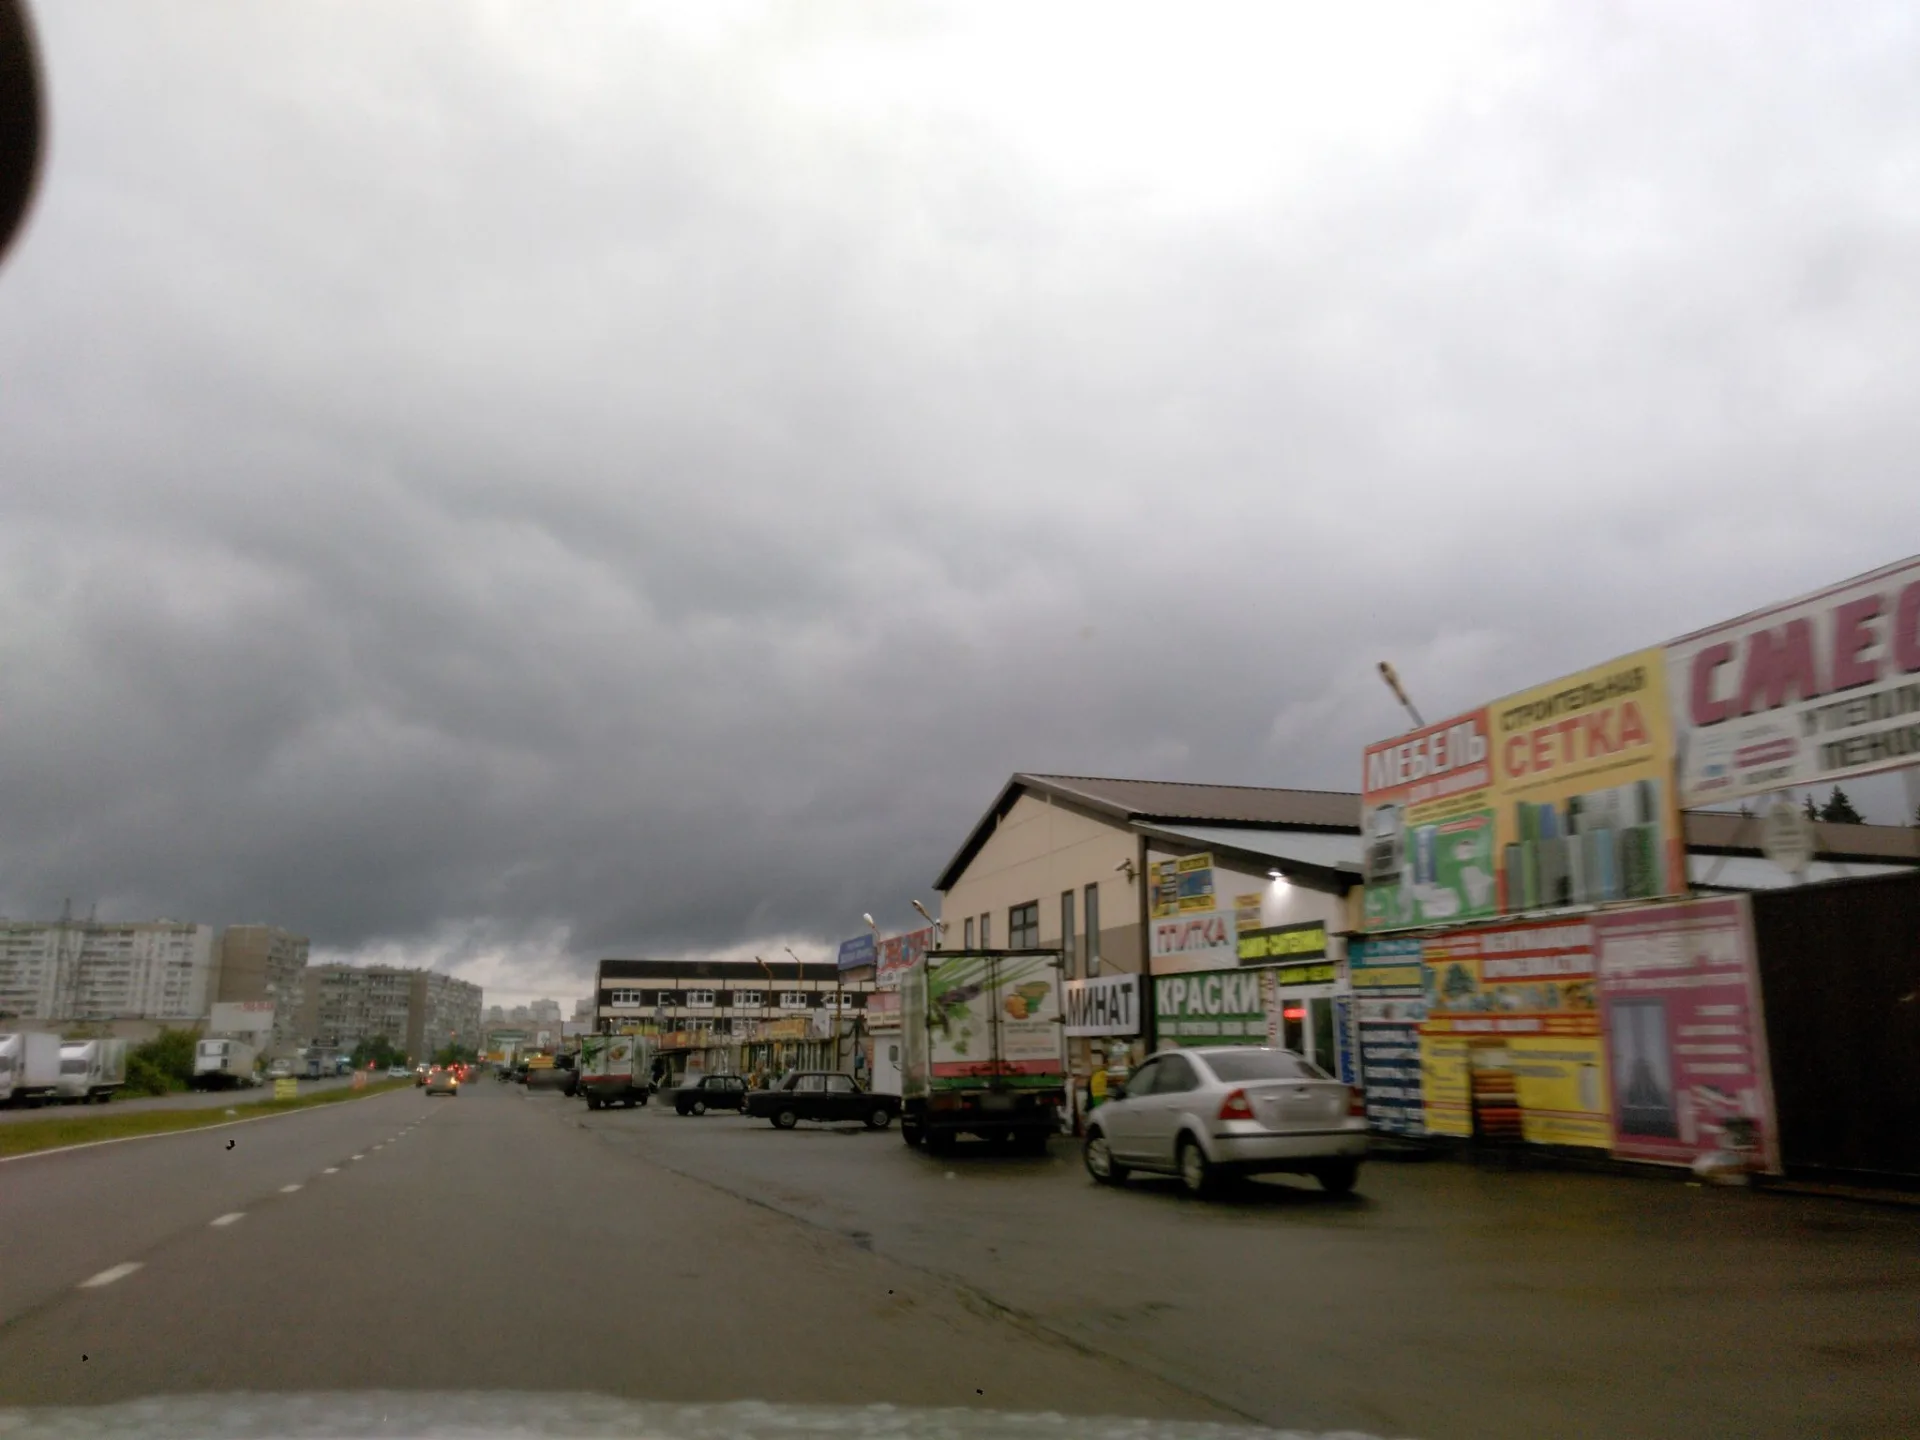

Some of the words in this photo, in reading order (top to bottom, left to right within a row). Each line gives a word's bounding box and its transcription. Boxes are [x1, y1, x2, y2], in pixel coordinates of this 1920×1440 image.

[1501, 666, 1648, 731] СТРОИТЕЛЬНАЯ
[1368, 719, 1487, 791] МЕБЕЛЬ
[1503, 699, 1652, 777] СЕТКА
[1067, 983, 1133, 1027] МИНАТ
[1157, 975, 1260, 1015] КРАСКИ
